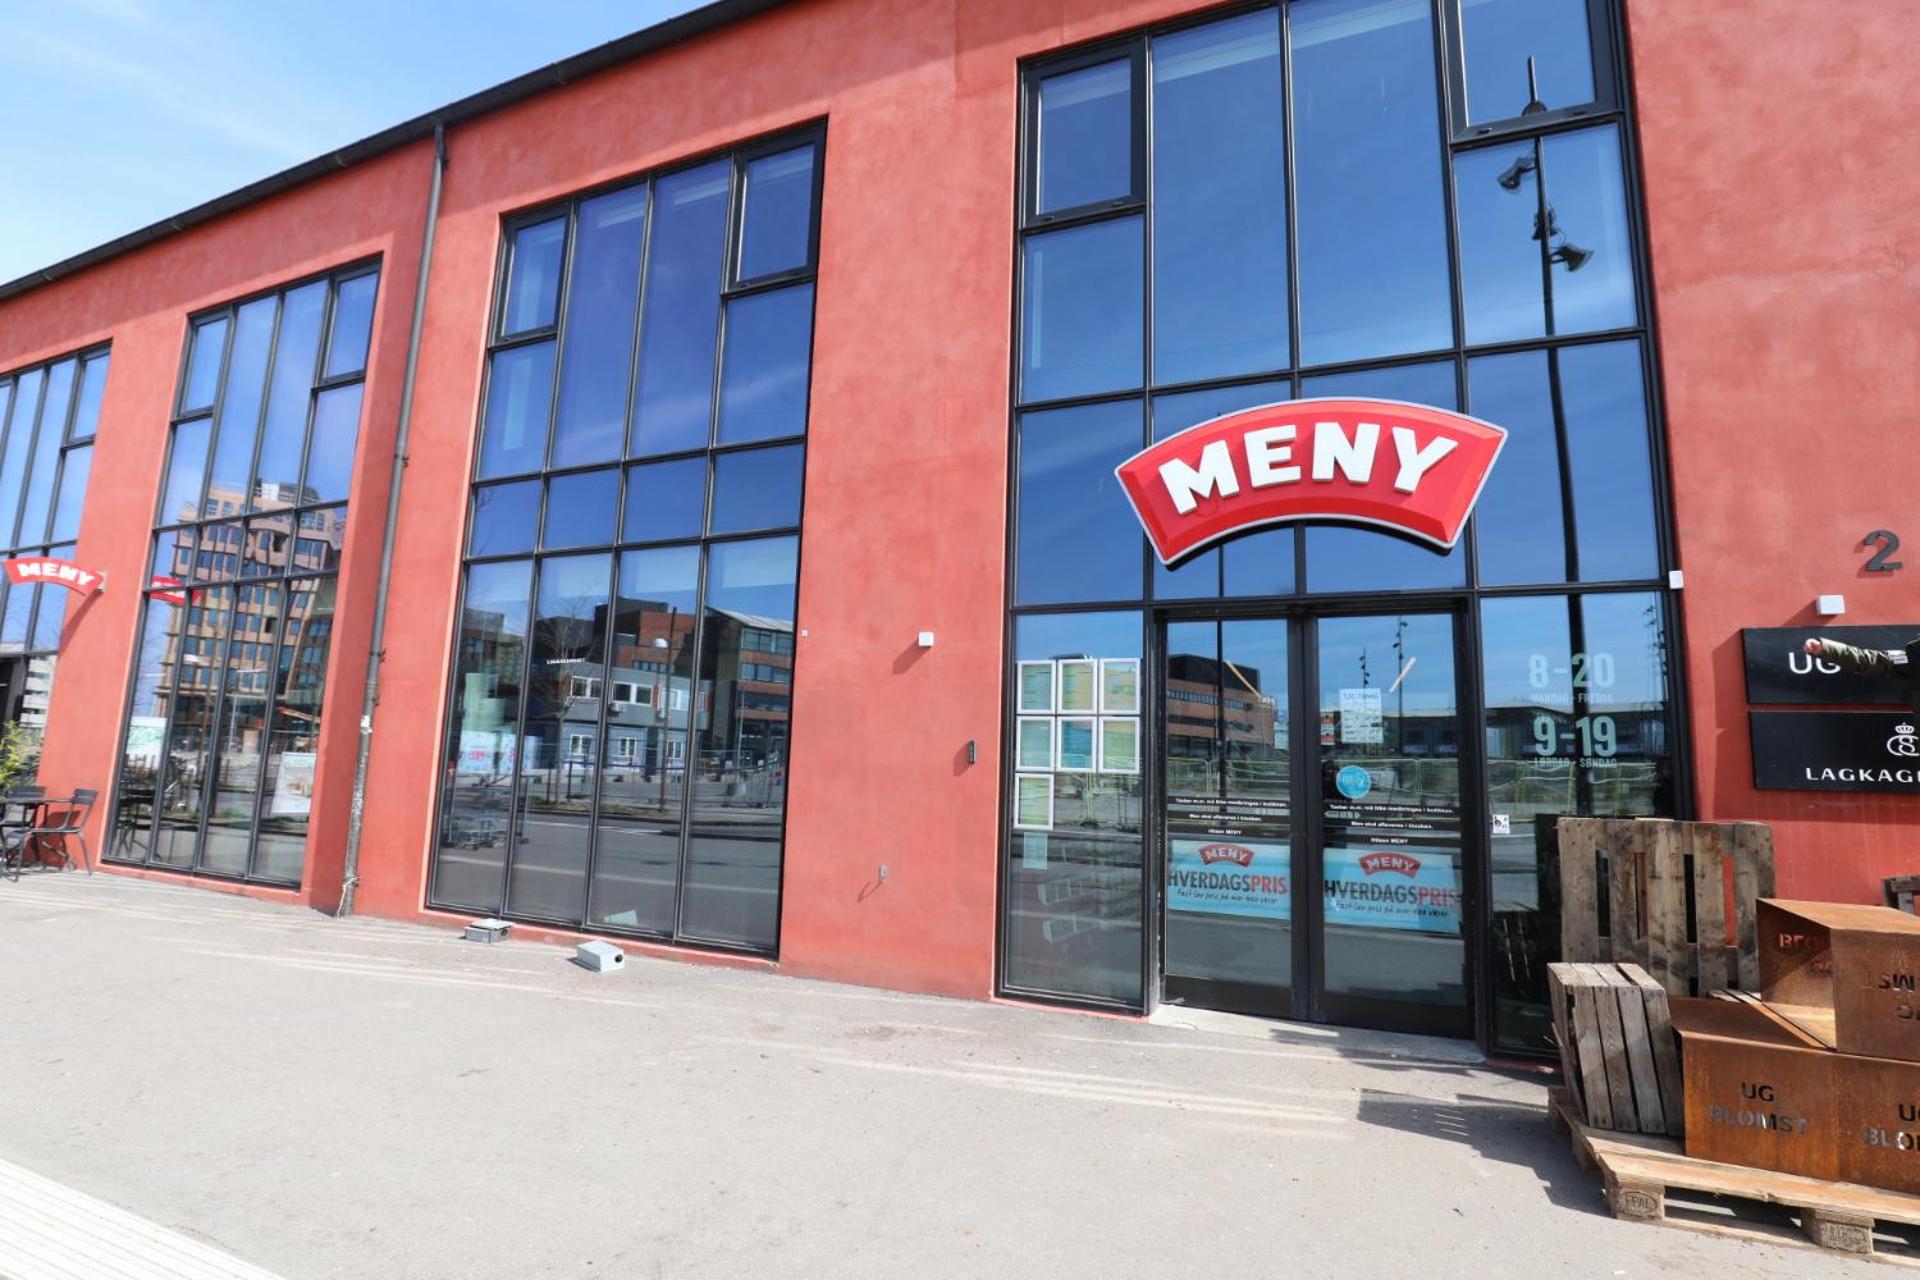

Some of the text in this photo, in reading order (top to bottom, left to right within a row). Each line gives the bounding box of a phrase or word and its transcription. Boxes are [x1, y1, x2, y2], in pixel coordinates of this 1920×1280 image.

[1157, 421, 1459, 516] MENY
[1863, 529, 1903, 572] 2
[17, 562, 96, 586] MENY
[1204, 847, 1249, 862] MENY
[1366, 856, 1415, 873] MENY
[1168, 869, 1288, 895] HVERDAGSPRIS
[1741, 1081, 1775, 1102] UG
[1898, 1103, 1920, 1122] U
[1864, 1127, 1920, 1152] BLO
